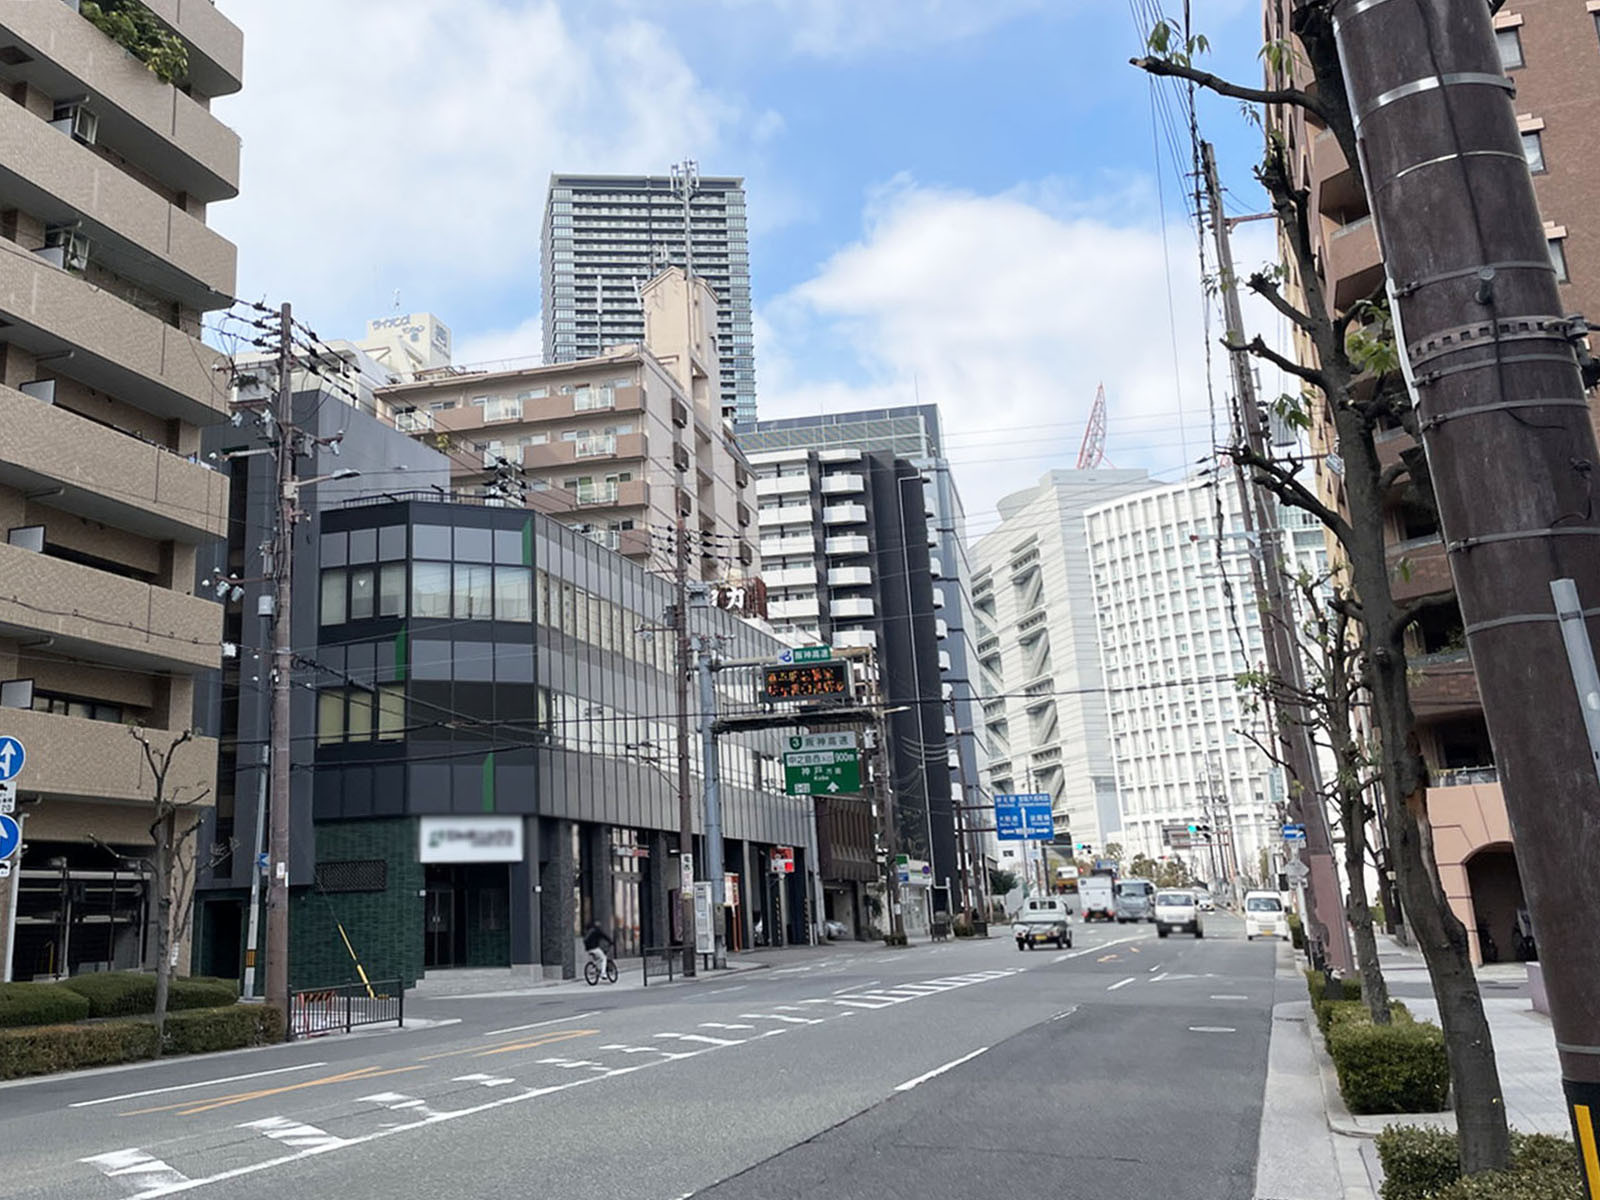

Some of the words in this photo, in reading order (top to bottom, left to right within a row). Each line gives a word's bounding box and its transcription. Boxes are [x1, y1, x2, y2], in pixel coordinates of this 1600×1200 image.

[794, 649, 829, 660] 阪神高速
[791, 737, 800, 748] 3
[804, 736, 848, 747] 阪神高速
